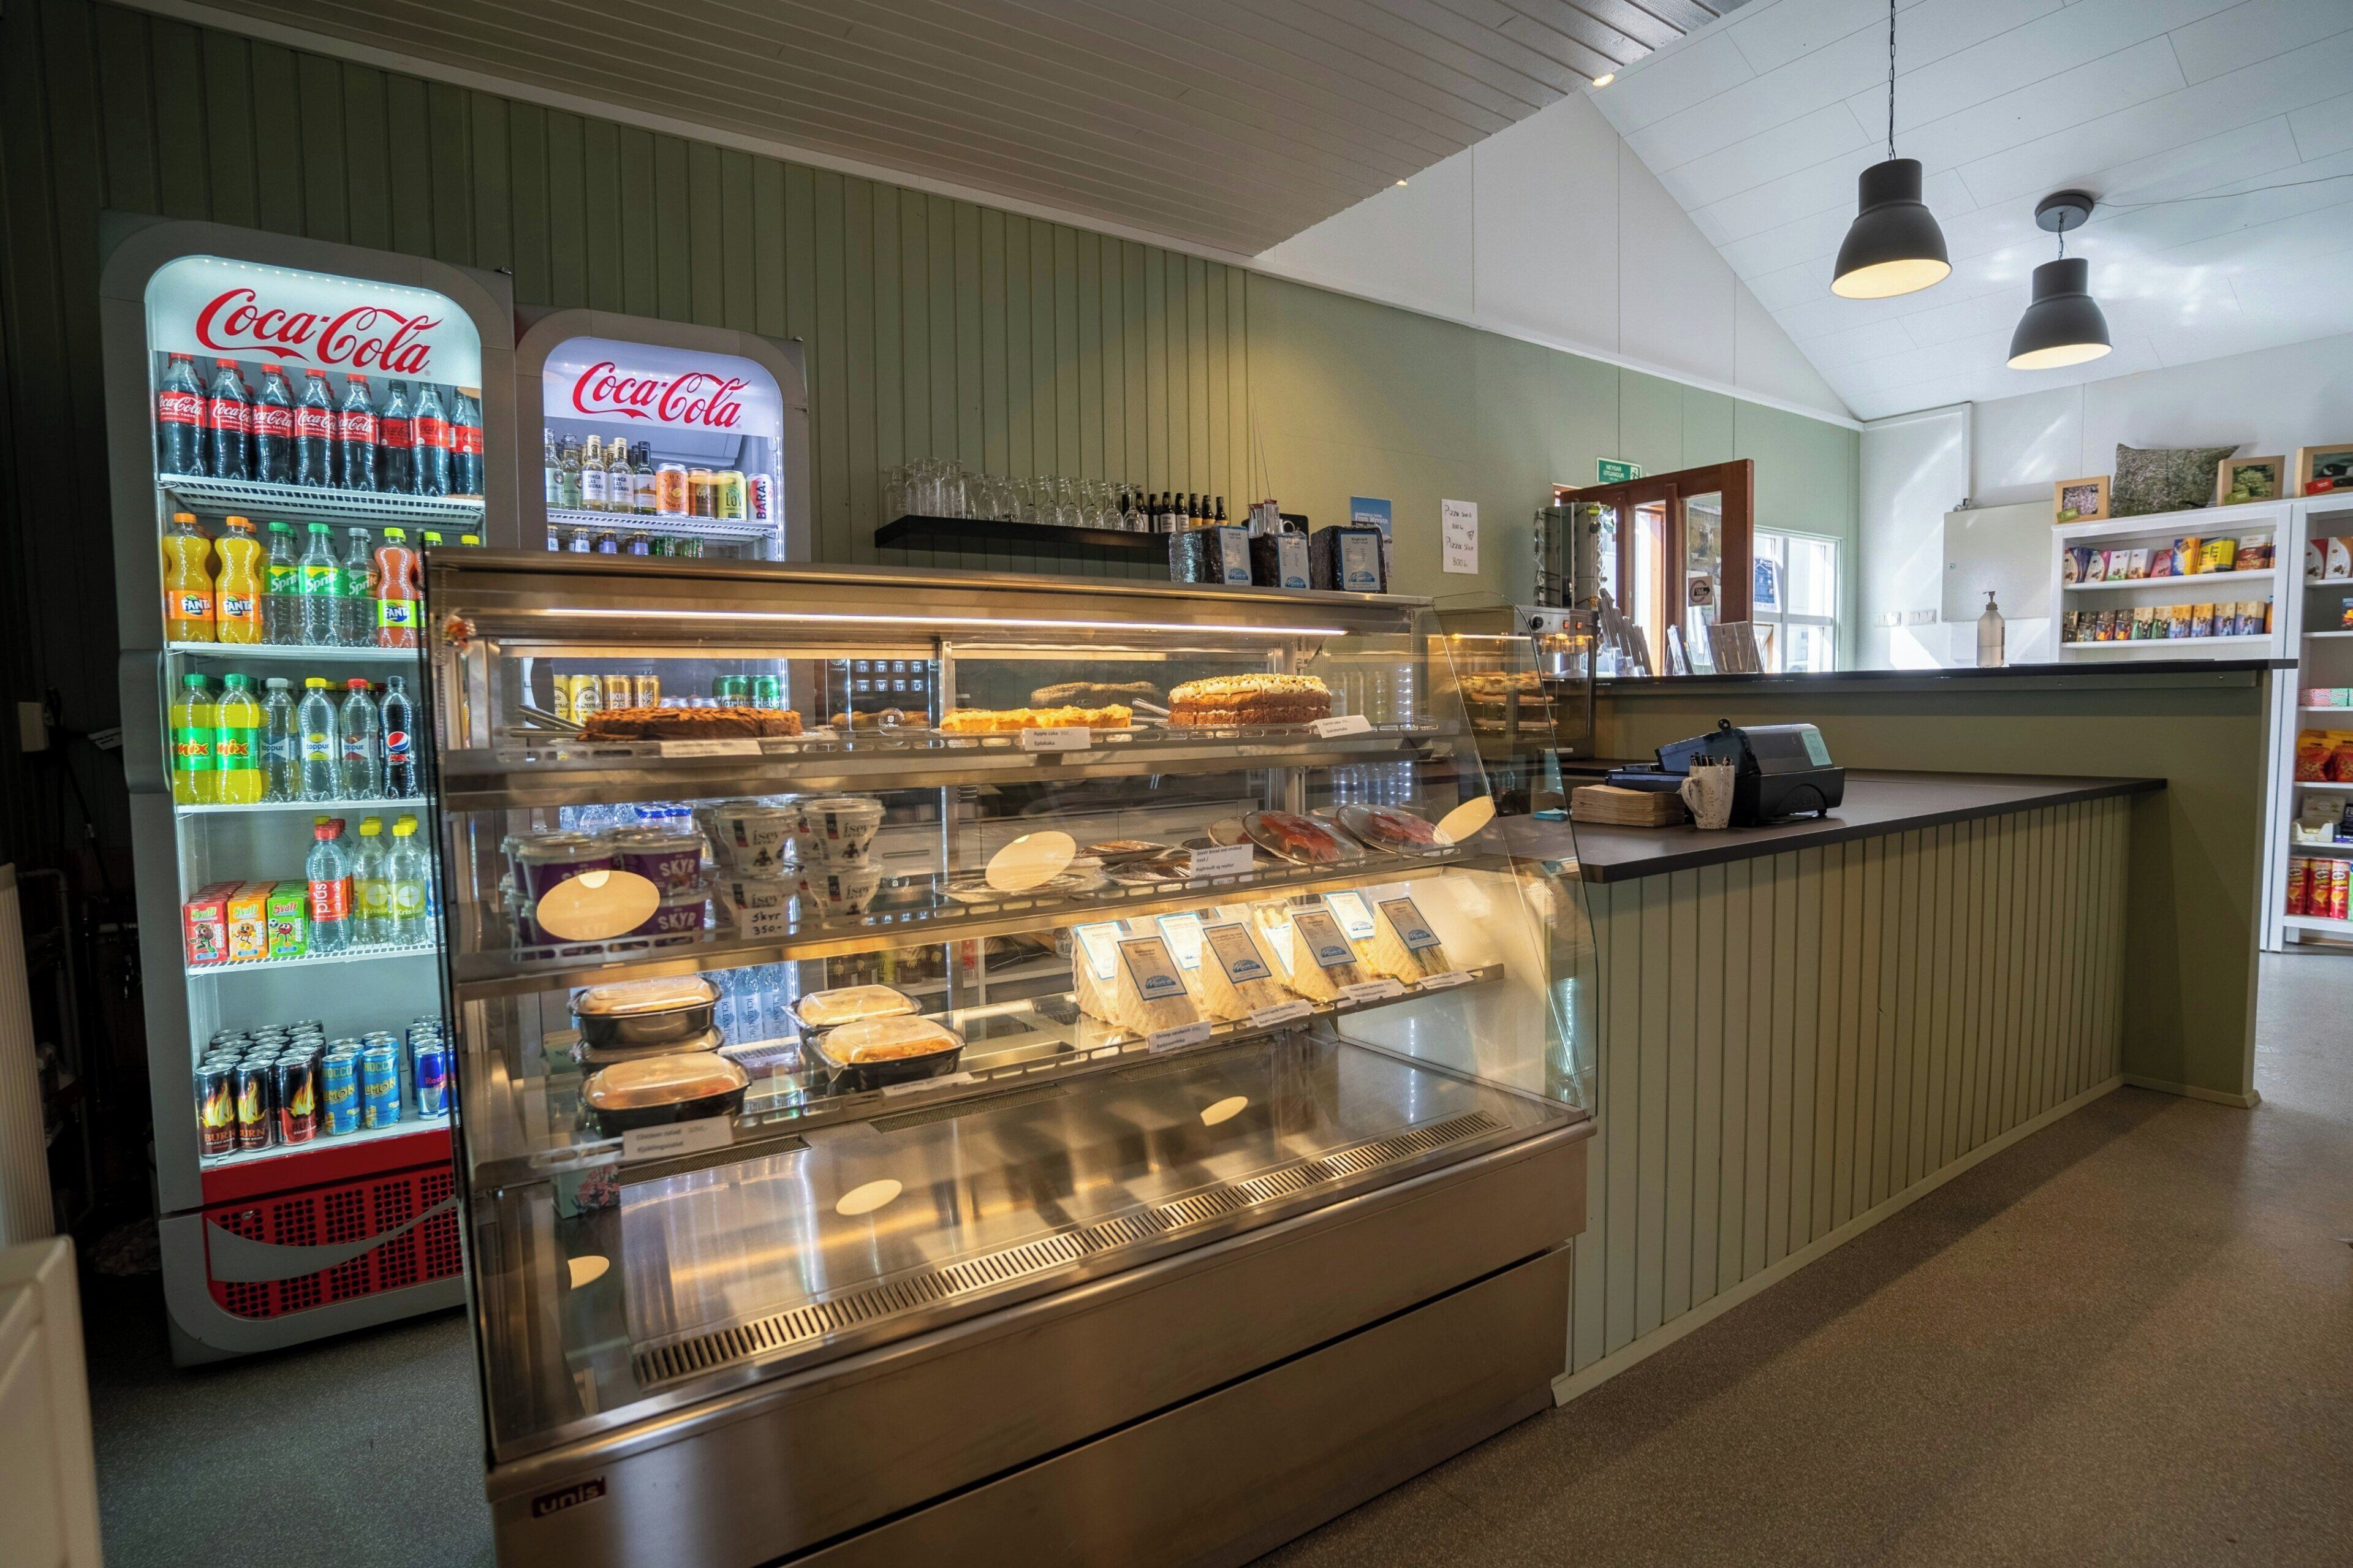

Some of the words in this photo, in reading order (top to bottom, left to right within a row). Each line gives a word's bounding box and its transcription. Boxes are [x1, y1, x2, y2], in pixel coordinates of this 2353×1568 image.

[196, 289, 444, 374] Coca-Cola
[572, 362, 751, 427] Coca-Cola
[306, 570, 338, 591] Sprite
[659, 858, 696, 877] SKYR
[273, 901, 297, 914] Svali
[314, 882, 331, 914] plús
[191, 906, 218, 919] Svali
[233, 904, 259, 918] Svali
[658, 912, 697, 930] SKYR
[721, 1001, 731, 1042] ICELANDIC
[746, 998, 756, 1039] ICELANDIC
[205, 1130, 237, 1142] BURN
